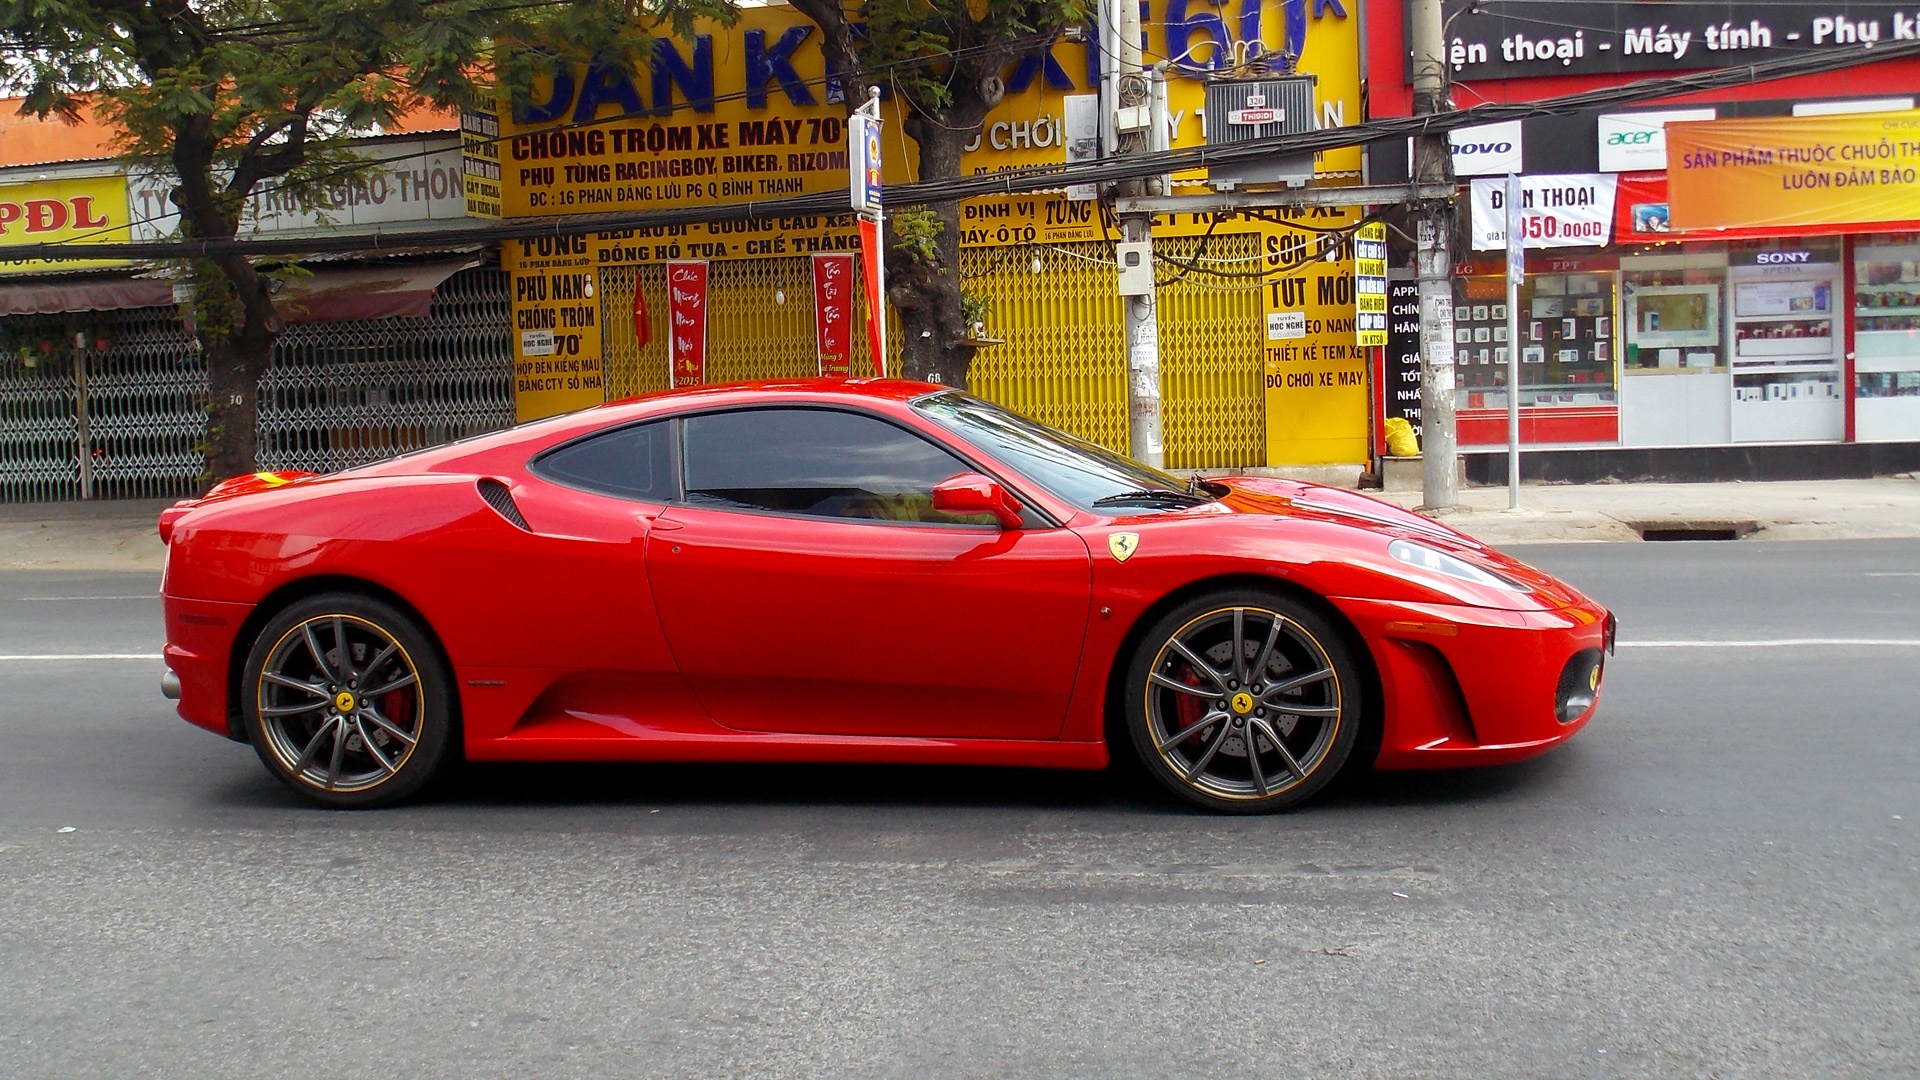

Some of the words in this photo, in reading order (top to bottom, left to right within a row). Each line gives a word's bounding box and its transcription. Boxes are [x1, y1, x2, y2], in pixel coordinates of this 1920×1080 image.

[1441, 37, 1487, 71] iện
[1501, 30, 1584, 66] thoại
[1623, 25, 1691, 60] Máy
[1705, 19, 1772, 50] tính
[1812, 15, 1879, 49] Phụ
[1248, 97, 1264, 106] 320
[609, 123, 692, 156] TRỘM
[697, 122, 730, 150] XE
[739, 116, 802, 146] MÁY
[990, 113, 1061, 150] CHƠI
[1607, 131, 1658, 145] acer
[1778, 143, 1836, 167] THUỘC
[520, 167, 555, 188] PHỤ
[564, 163, 611, 183] TÙNG
[615, 156, 717, 181] RACINGBOY,
[723, 154, 783, 174] BIKER,
[1783, 169, 1829, 190] LUÔN
[1835, 165, 1875, 187] ĐẢM
[1881, 164, 1915, 185] BẢO
[330, 173, 387, 208] GIAO
[560, 190, 574, 205] 16
[579, 188, 612, 203] PHAN
[687, 183, 702, 198] P6
[708, 181, 717, 198] Q
[722, 177, 753, 196] BÌNH
[759, 177, 803, 197] THẠNH
[1491, 189, 1534, 210] ĐN
[1541, 186, 1595, 210] THOẠI
[965, 202, 1010, 222] ĐỊNH
[1017, 201, 1035, 219] VỊ
[1045, 195, 1092, 225] TÙNG
[1044, 232, 1051, 240] 16
[1052, 231, 1067, 239] PHAN
[598, 241, 649, 262] ĐỒNG
[654, 238, 681, 260] HỒ
[687, 242, 728, 258] TUA
[746, 233, 785, 254] CHẾ
[1266, 231, 1307, 266] SƠN
[1756, 252, 1811, 264] SONY
[1455, 265, 1473, 274] LG
[1553, 260, 1579, 270] FPT
[516, 269, 546, 302] PHỦ
[518, 303, 556, 329] CHỐNG
[1394, 322, 1420, 333] HÃN
[838, 352, 843, 360] 9
[1266, 340, 1298, 362] THIẾT
[1303, 340, 1318, 360] KẾ
[1322, 345, 1346, 360] TEM
[1349, 344, 1363, 359] XE
[1401, 352, 1421, 364] GIÁ
[516, 360, 533, 376] HỘP
[535, 358, 552, 374] ĐÈN
[555, 355, 579, 373] KIẾNG
[1400, 369, 1421, 382] TỐT
[545, 378, 563, 391] CTY
[678, 376, 700, 386] 2015
[927, 373, 941, 383] 68
[1266, 366, 1282, 388] ĐỒ
[1287, 370, 1314, 387] CHƠI
[1319, 371, 1333, 386] XE
[1397, 388, 1421, 400] NHẤ
[1403, 408, 1421, 420] THỊ
